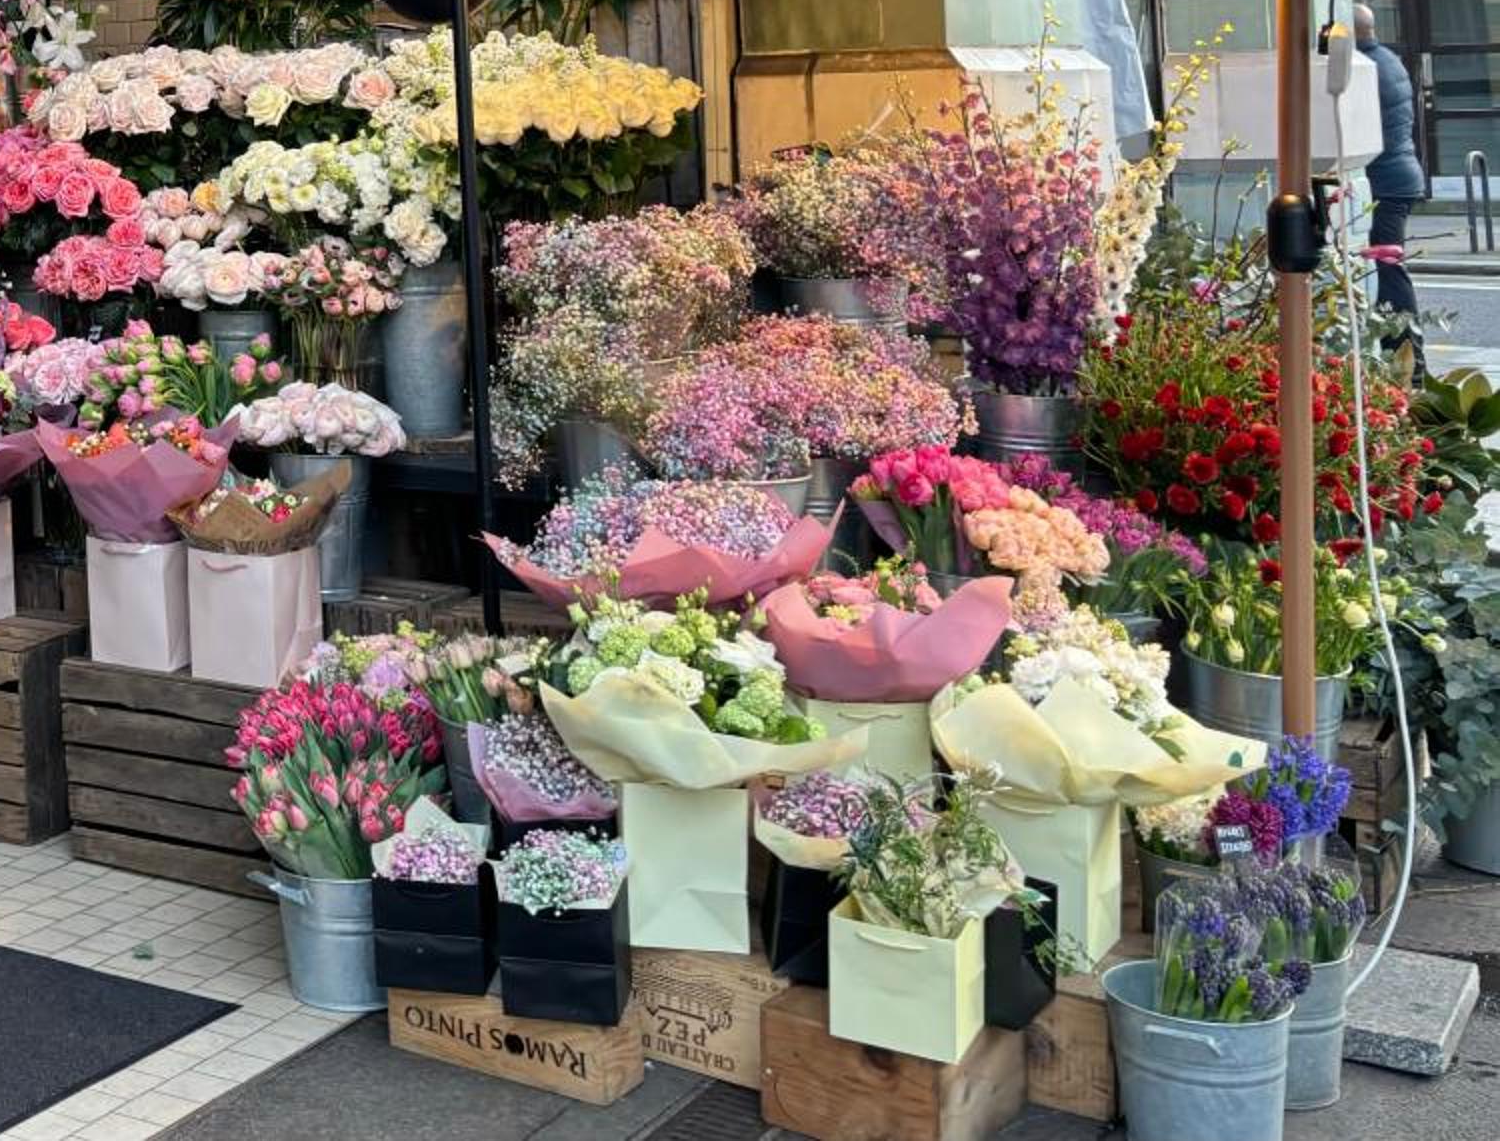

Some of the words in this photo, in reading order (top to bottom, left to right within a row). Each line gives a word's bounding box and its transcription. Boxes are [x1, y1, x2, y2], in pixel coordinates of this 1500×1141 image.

[404, 1005, 482, 1050] PINTO
[657, 1015, 707, 1048] PEZ
[489, 1031, 587, 1080] RAMOS
